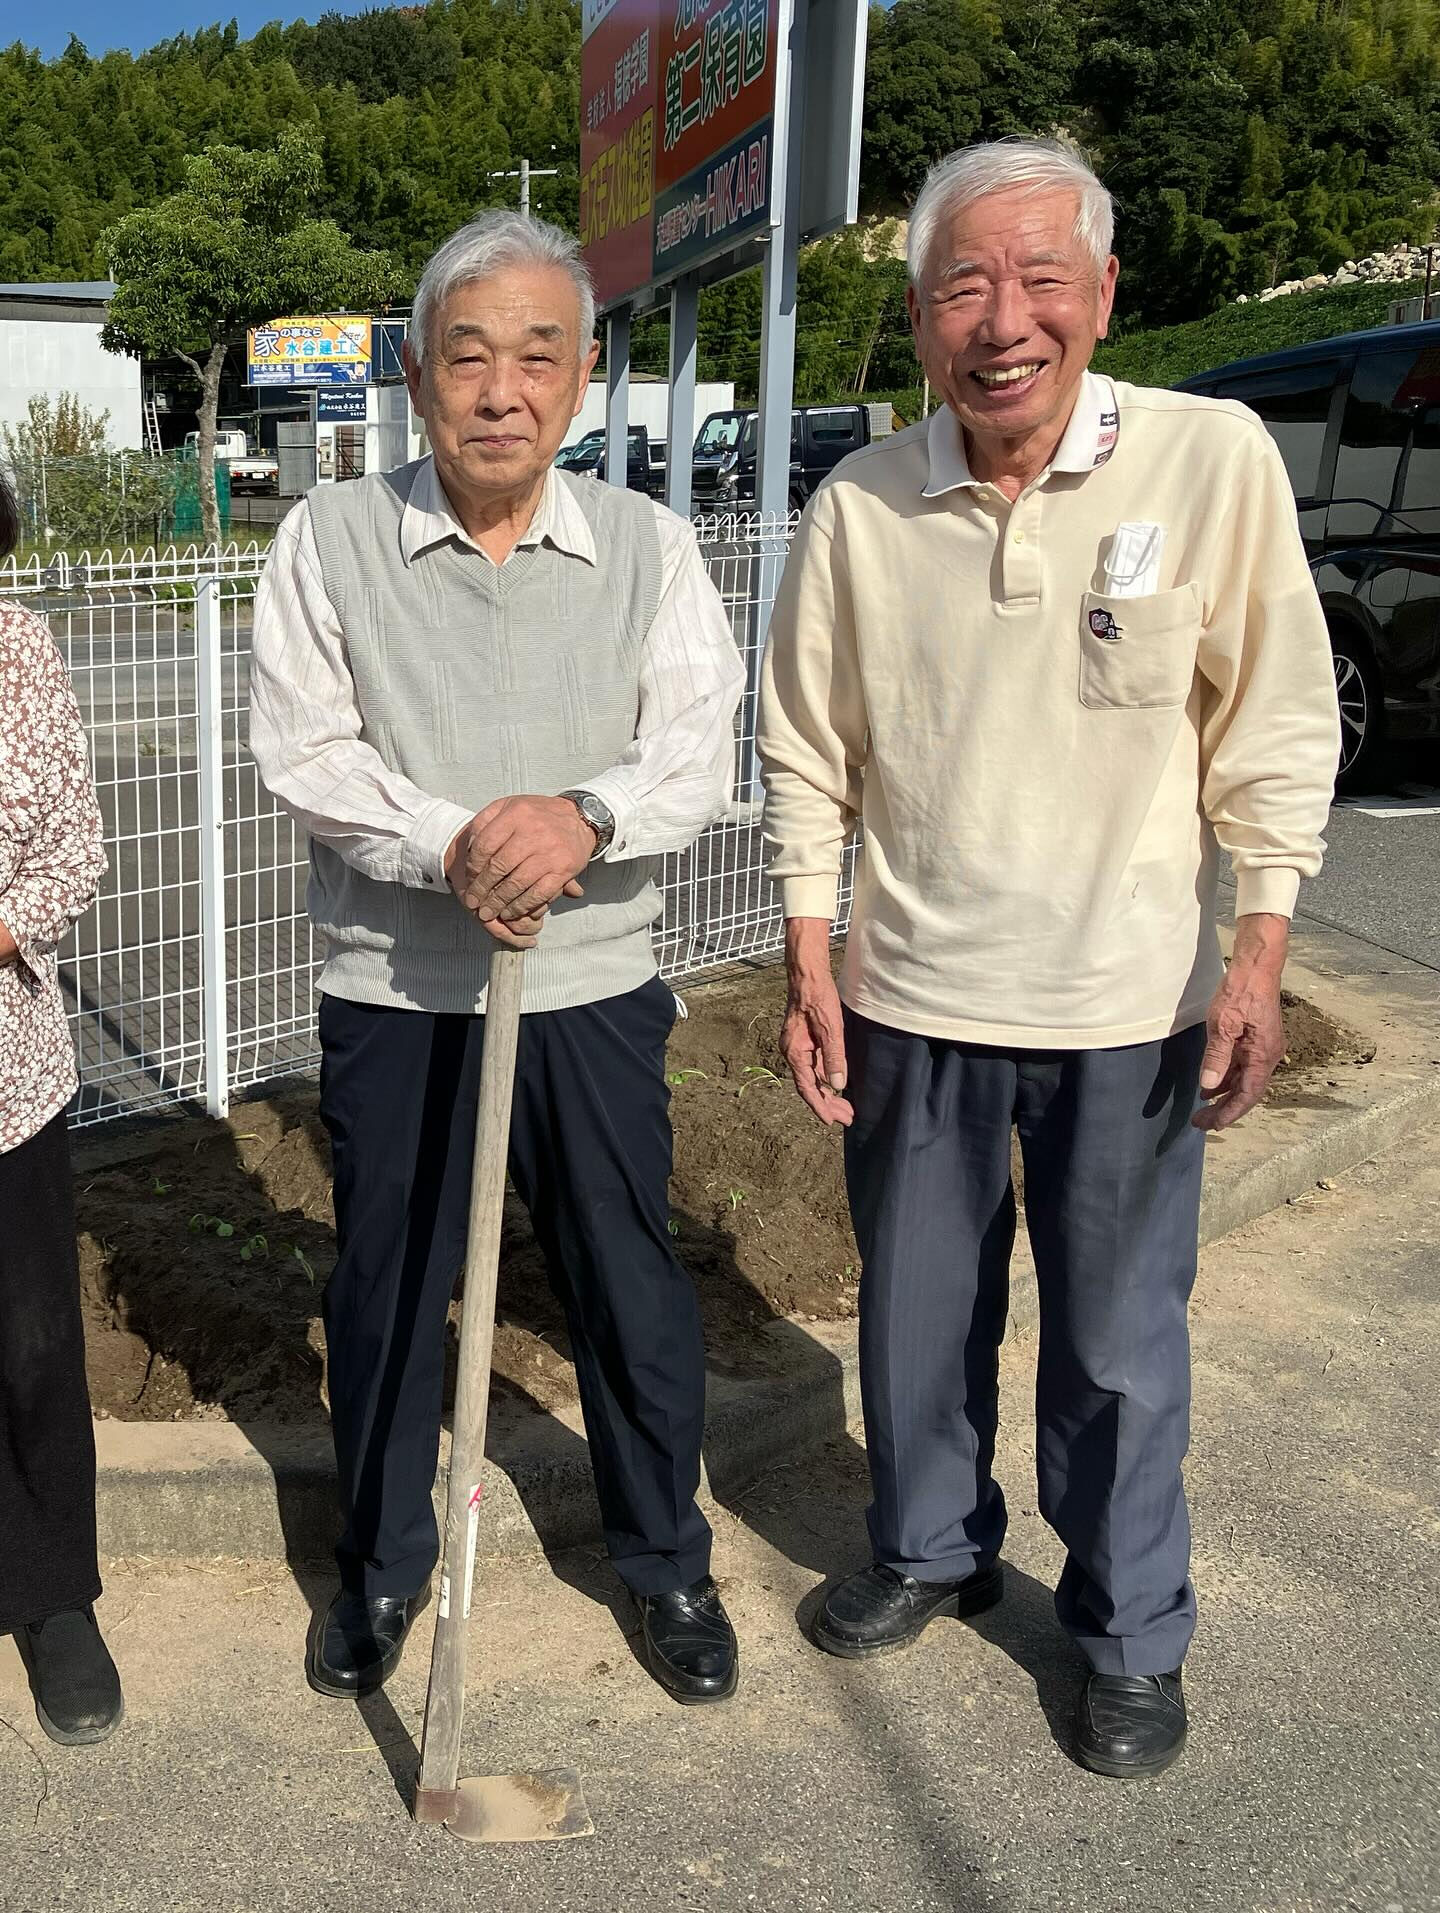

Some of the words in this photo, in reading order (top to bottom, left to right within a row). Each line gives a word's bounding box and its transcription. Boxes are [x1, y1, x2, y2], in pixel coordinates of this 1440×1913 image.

[663, 0, 768, 152] 第二保育園
[705, 134, 768, 239] HIKARI
